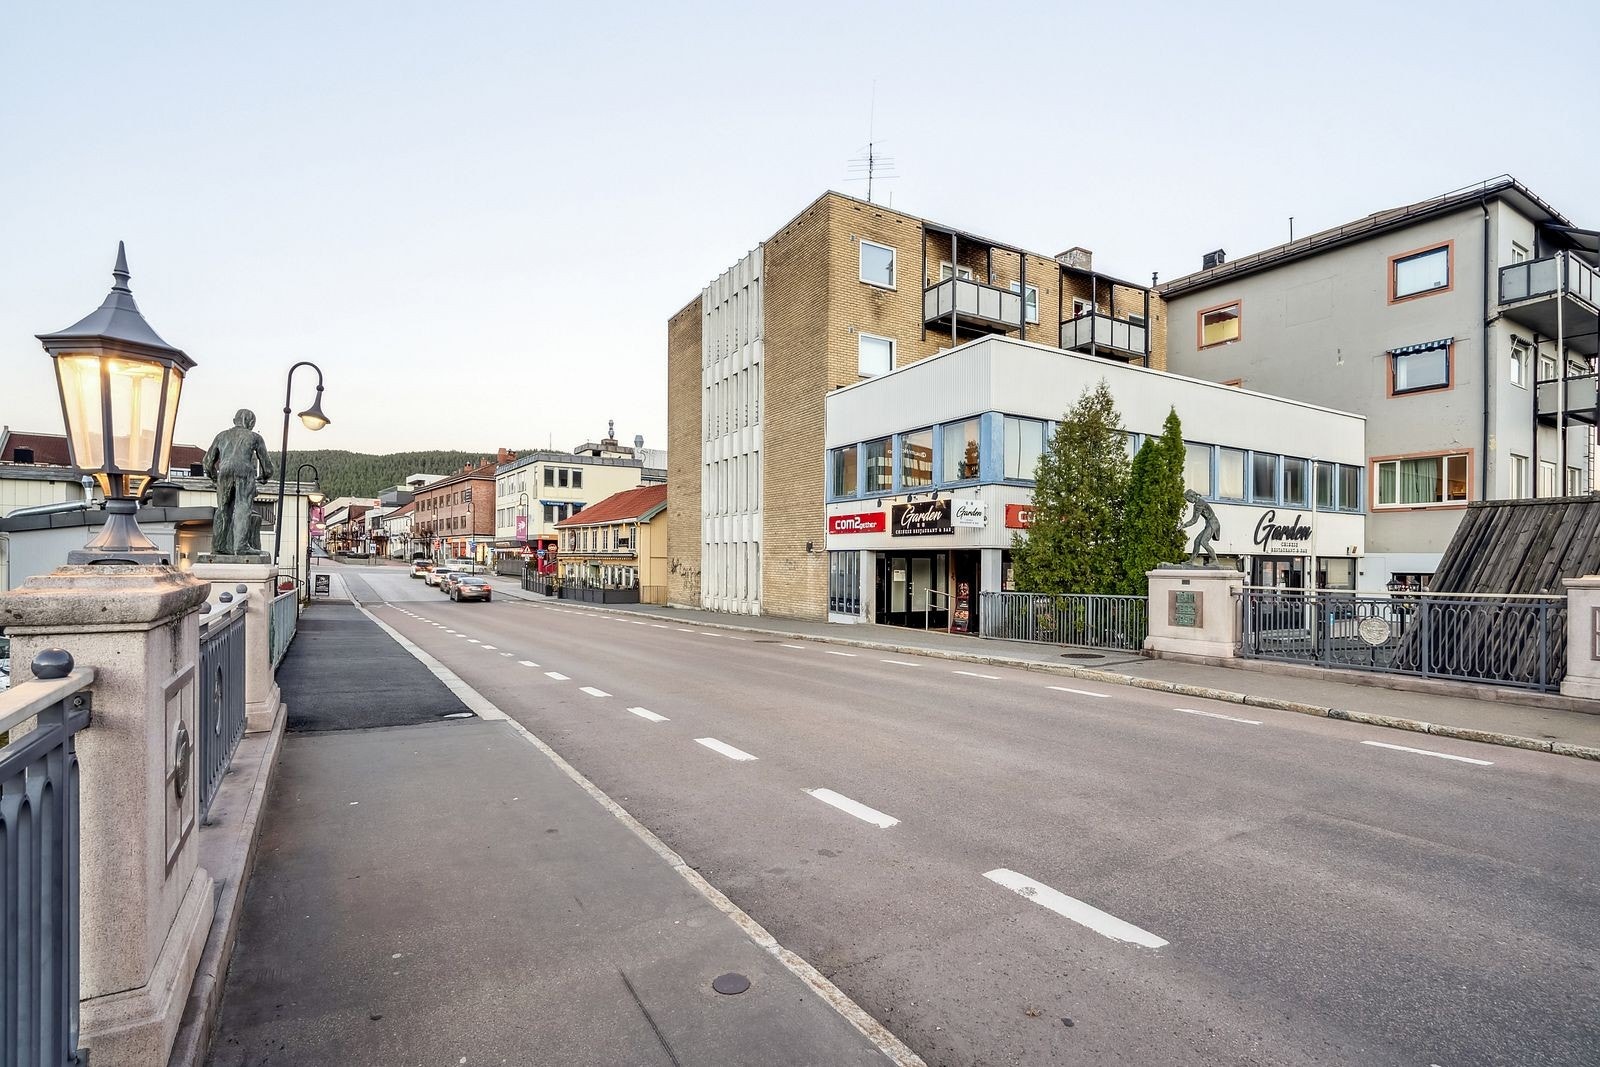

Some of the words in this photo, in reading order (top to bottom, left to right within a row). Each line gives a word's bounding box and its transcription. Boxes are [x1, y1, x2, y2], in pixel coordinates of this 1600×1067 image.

[900, 505, 943, 529] Garden
[956, 505, 982, 520] Garden
[835, 516, 877, 530] com2gether
[1254, 510, 1312, 552] Garden
